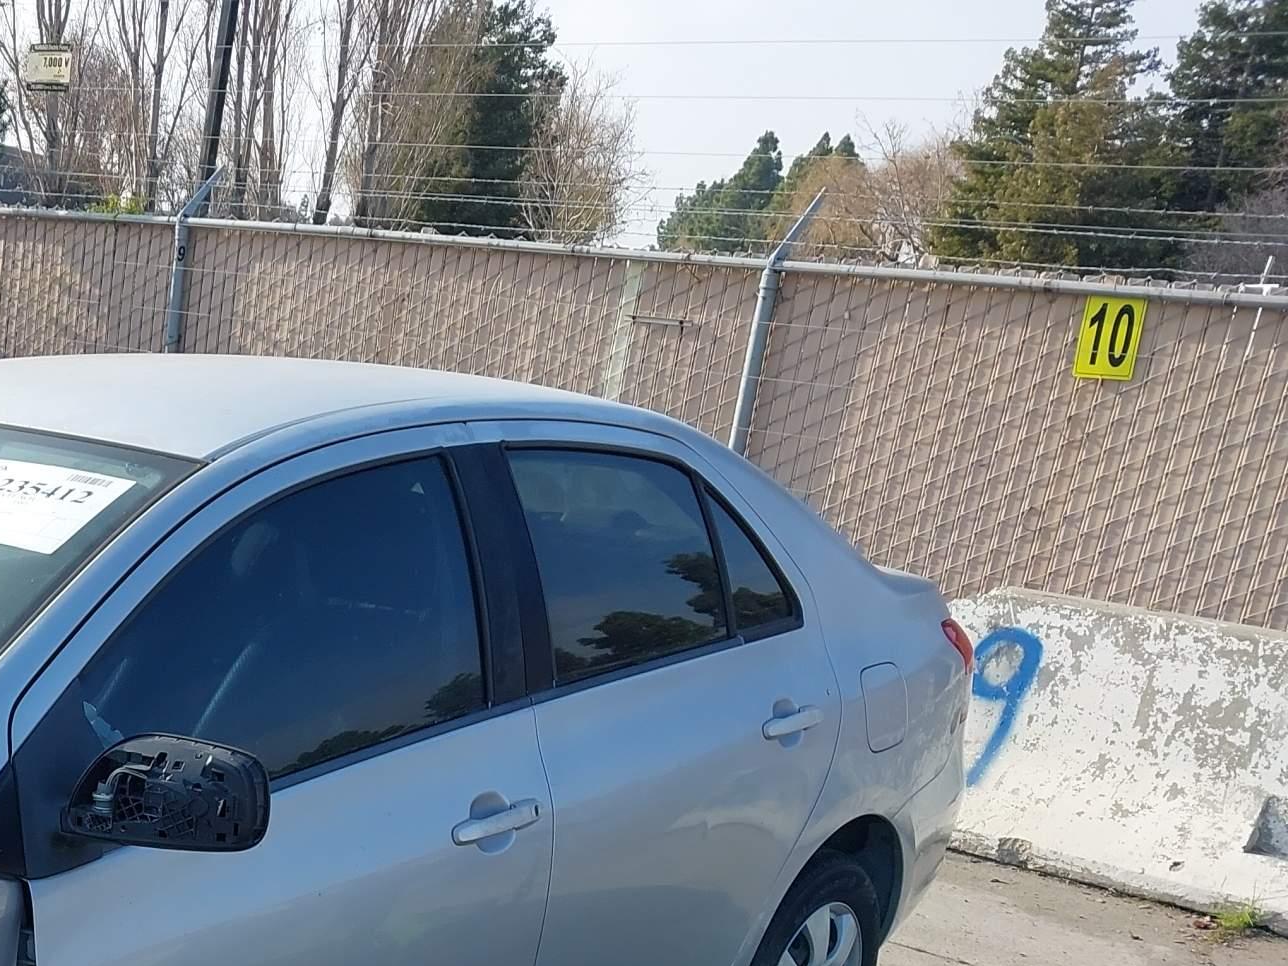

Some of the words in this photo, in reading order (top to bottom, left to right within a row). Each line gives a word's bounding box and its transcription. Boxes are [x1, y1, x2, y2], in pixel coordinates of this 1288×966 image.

[43, 57, 63, 69] 7,000
[64, 57, 70, 68] V
[177, 245, 186, 262] 9
[1089, 302, 1135, 368] 10
[966, 626, 1044, 788] 9
